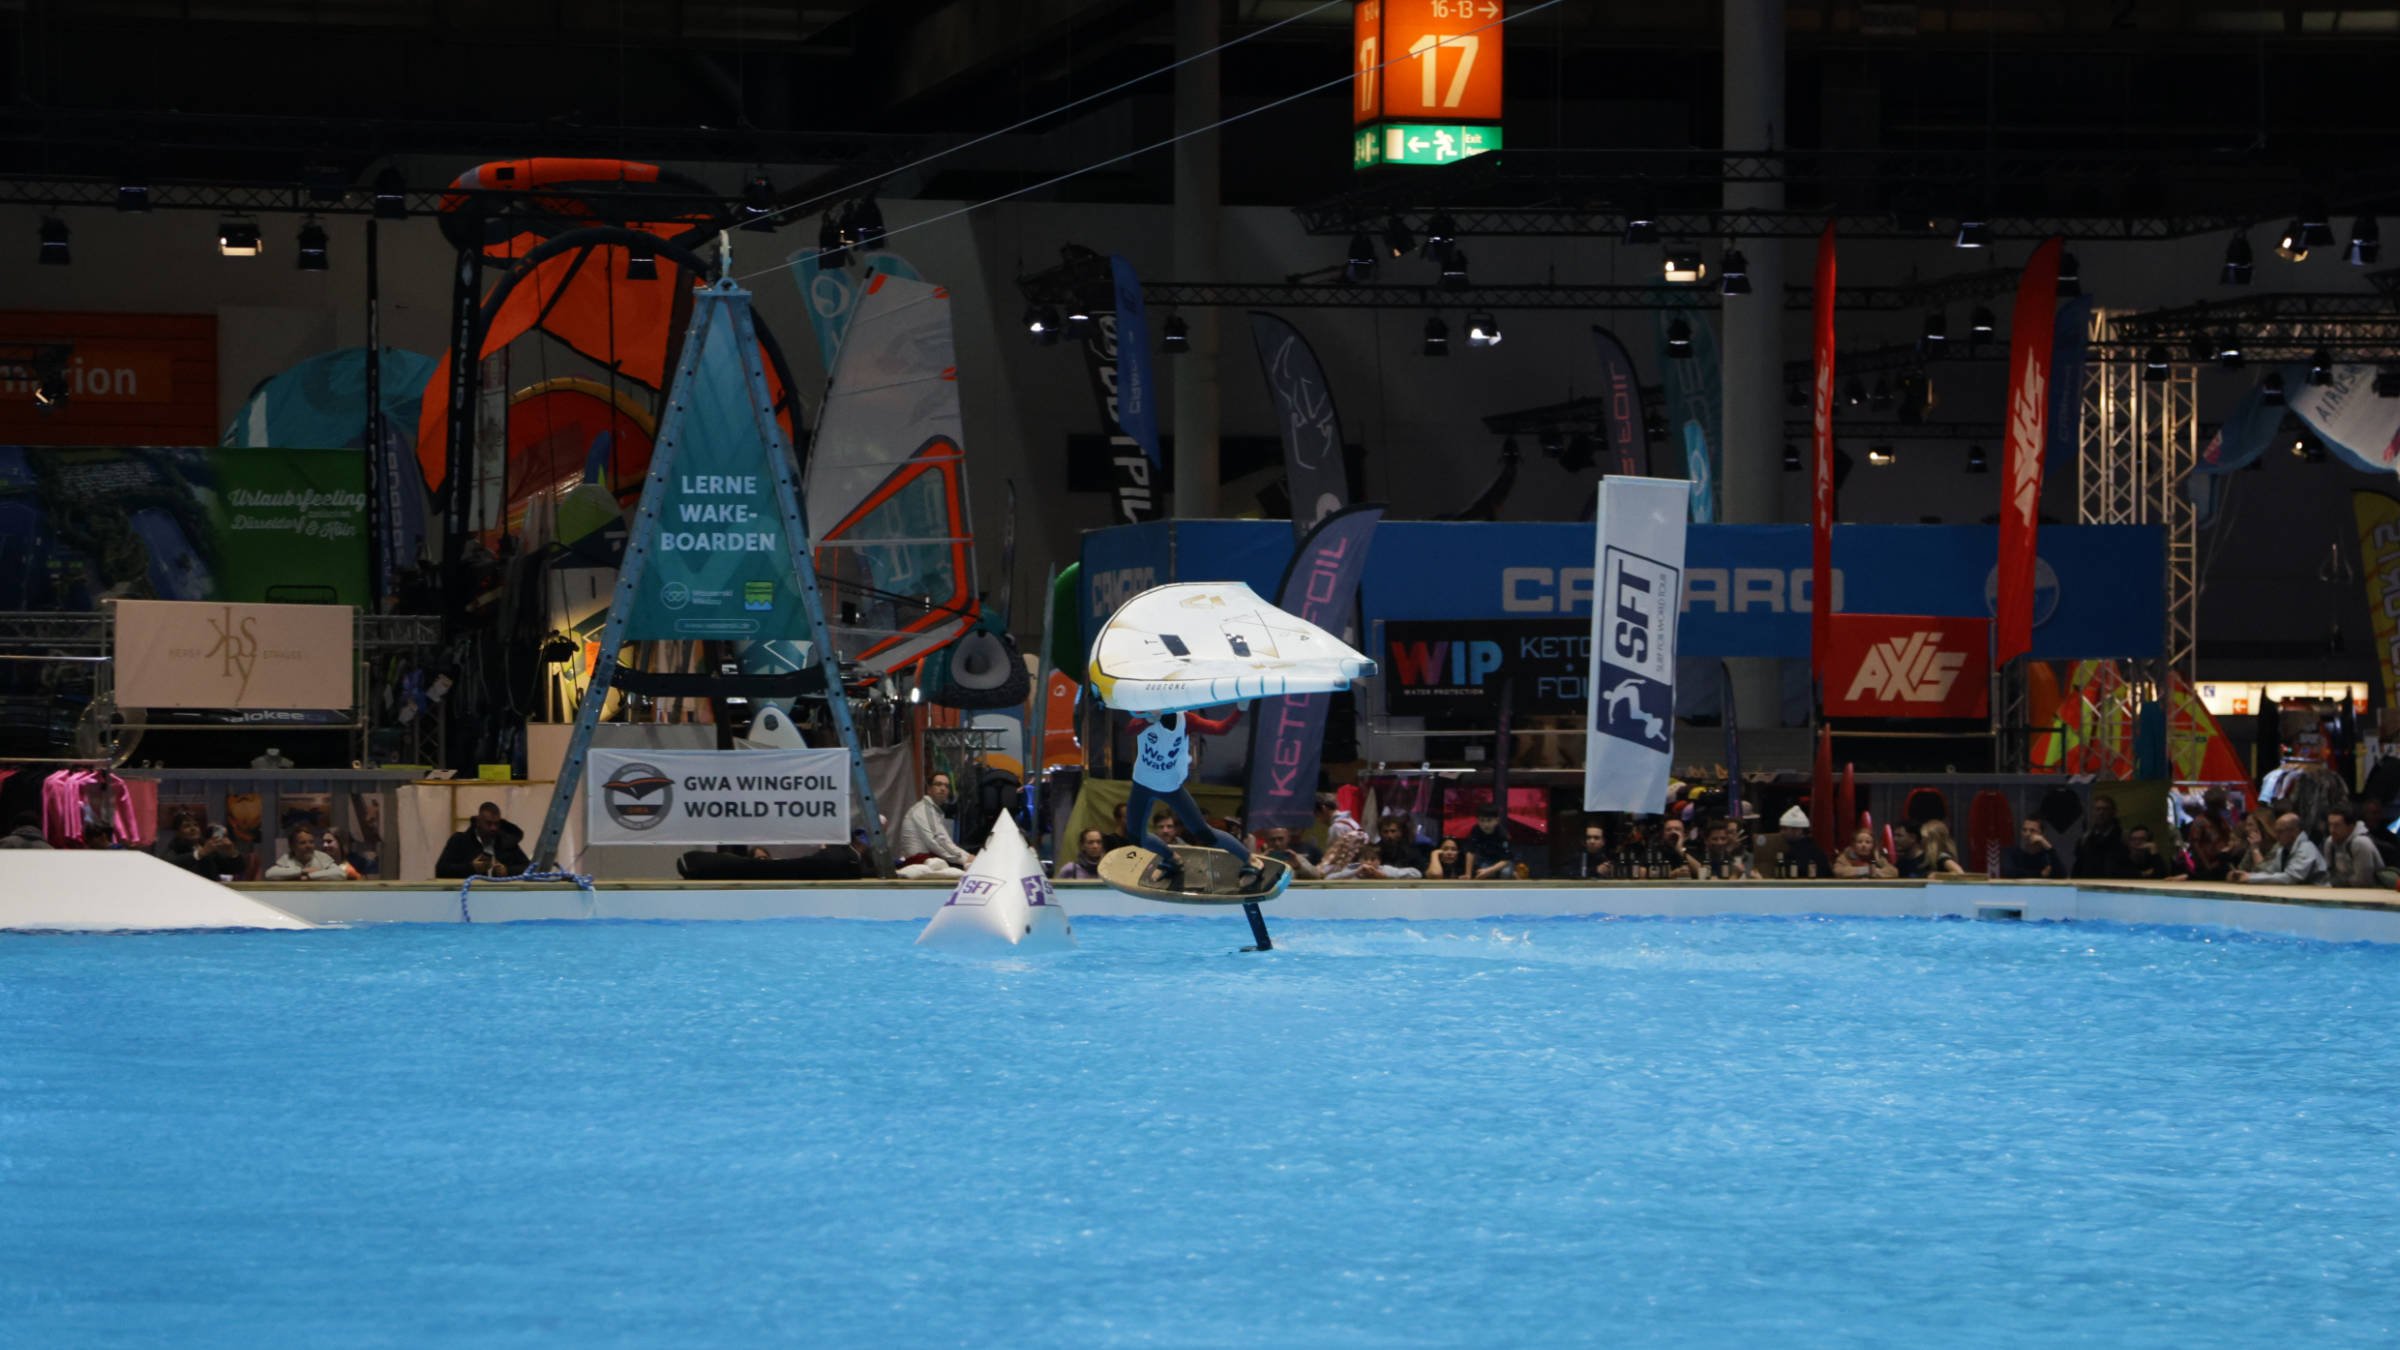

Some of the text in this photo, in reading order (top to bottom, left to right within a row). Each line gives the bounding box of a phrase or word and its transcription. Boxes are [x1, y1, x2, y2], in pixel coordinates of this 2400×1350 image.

[1430, 0, 1474, 19] 16-13
[1408, 34, 1479, 108] 17
[682, 475, 757, 494] LERNE
[227, 487, 366, 513] Urlaubsfeeling
[679, 503, 758, 523] WAKE-
[660, 532, 776, 551] BOARDEN
[1502, 567, 1845, 613] CAARO
[1616, 559, 1650, 663] SFT
[1391, 640, 1504, 686] WIP
[1403, 688, 1485, 696] WATER PROTECTION
[1537, 675, 1588, 700] FOI
[1142, 754, 1177, 771] water
[684, 775, 837, 791] GWA WINGFOIL
[684, 800, 837, 818] WORLD TOUR
[963, 880, 999, 895] SFT
